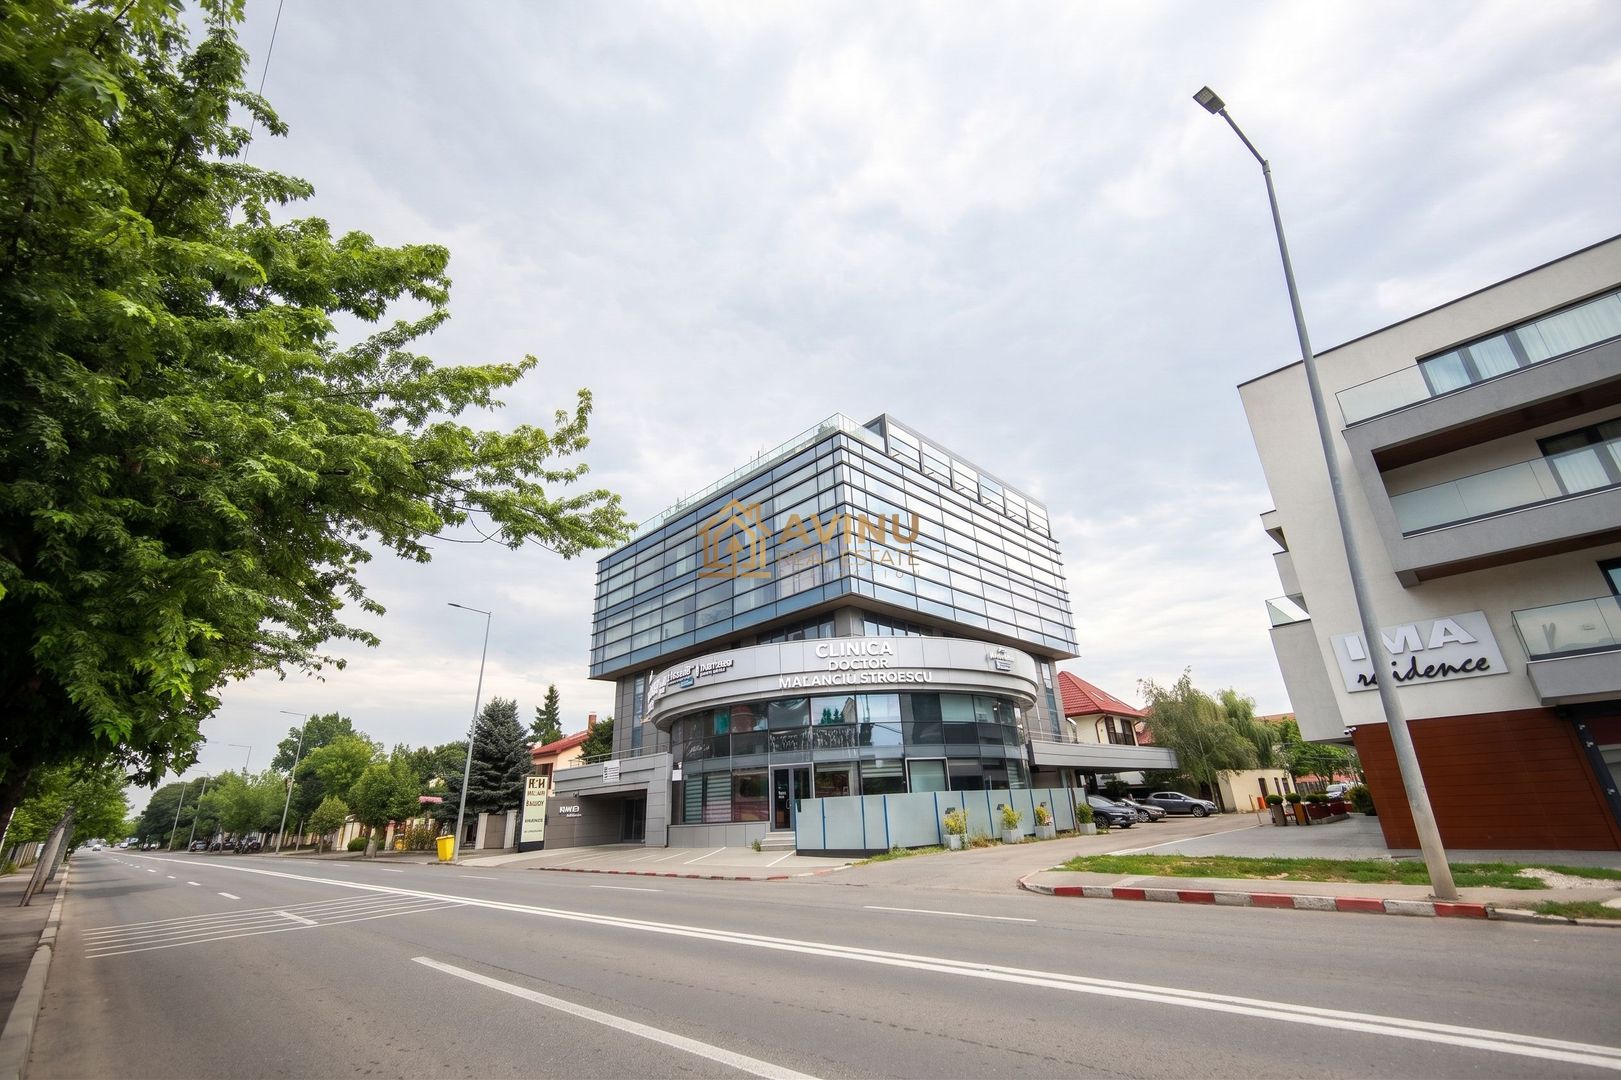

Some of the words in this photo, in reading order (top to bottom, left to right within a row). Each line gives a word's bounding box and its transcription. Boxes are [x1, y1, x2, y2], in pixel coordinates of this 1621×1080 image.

[1344, 618, 1478, 661] IMA
[815, 640, 894, 659] CLINICA
[828, 658, 889, 672] DOCTOR
[778, 674, 857, 690] MALANCIU
[861, 671, 934, 685] STROESCU
